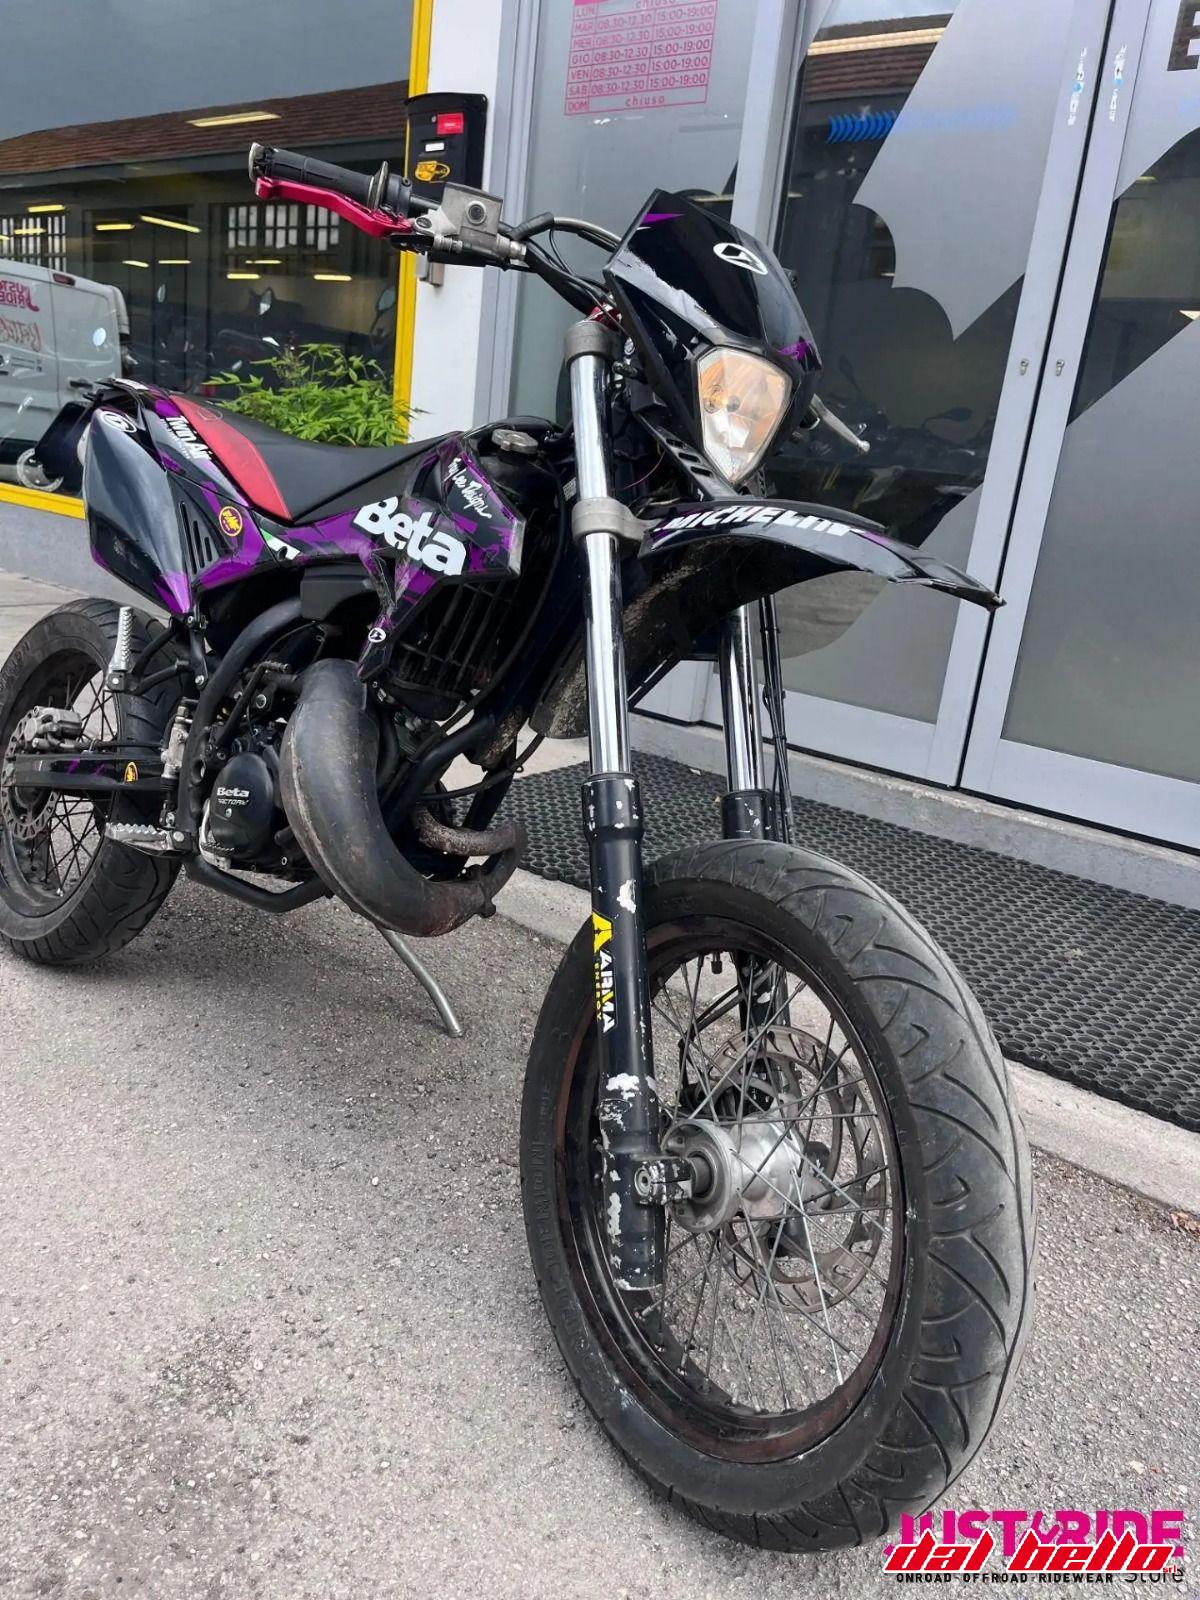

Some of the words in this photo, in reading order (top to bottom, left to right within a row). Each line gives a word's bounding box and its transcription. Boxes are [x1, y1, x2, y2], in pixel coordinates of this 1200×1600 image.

[576, 7, 594, 18] LUN
[575, 22, 593, 32] MAR
[572, 53, 590, 64] GIO
[571, 69, 589, 80] VEN
[569, 85, 588, 96] SAB
[568, 100, 588, 111] DOM
[625, 95, 665, 107] chiuso
[662, 505, 850, 537] MICHELIN
[353, 496, 467, 576] Beta
[216, 787, 250, 797] Beta
[600, 949, 614, 1033] ARMA
